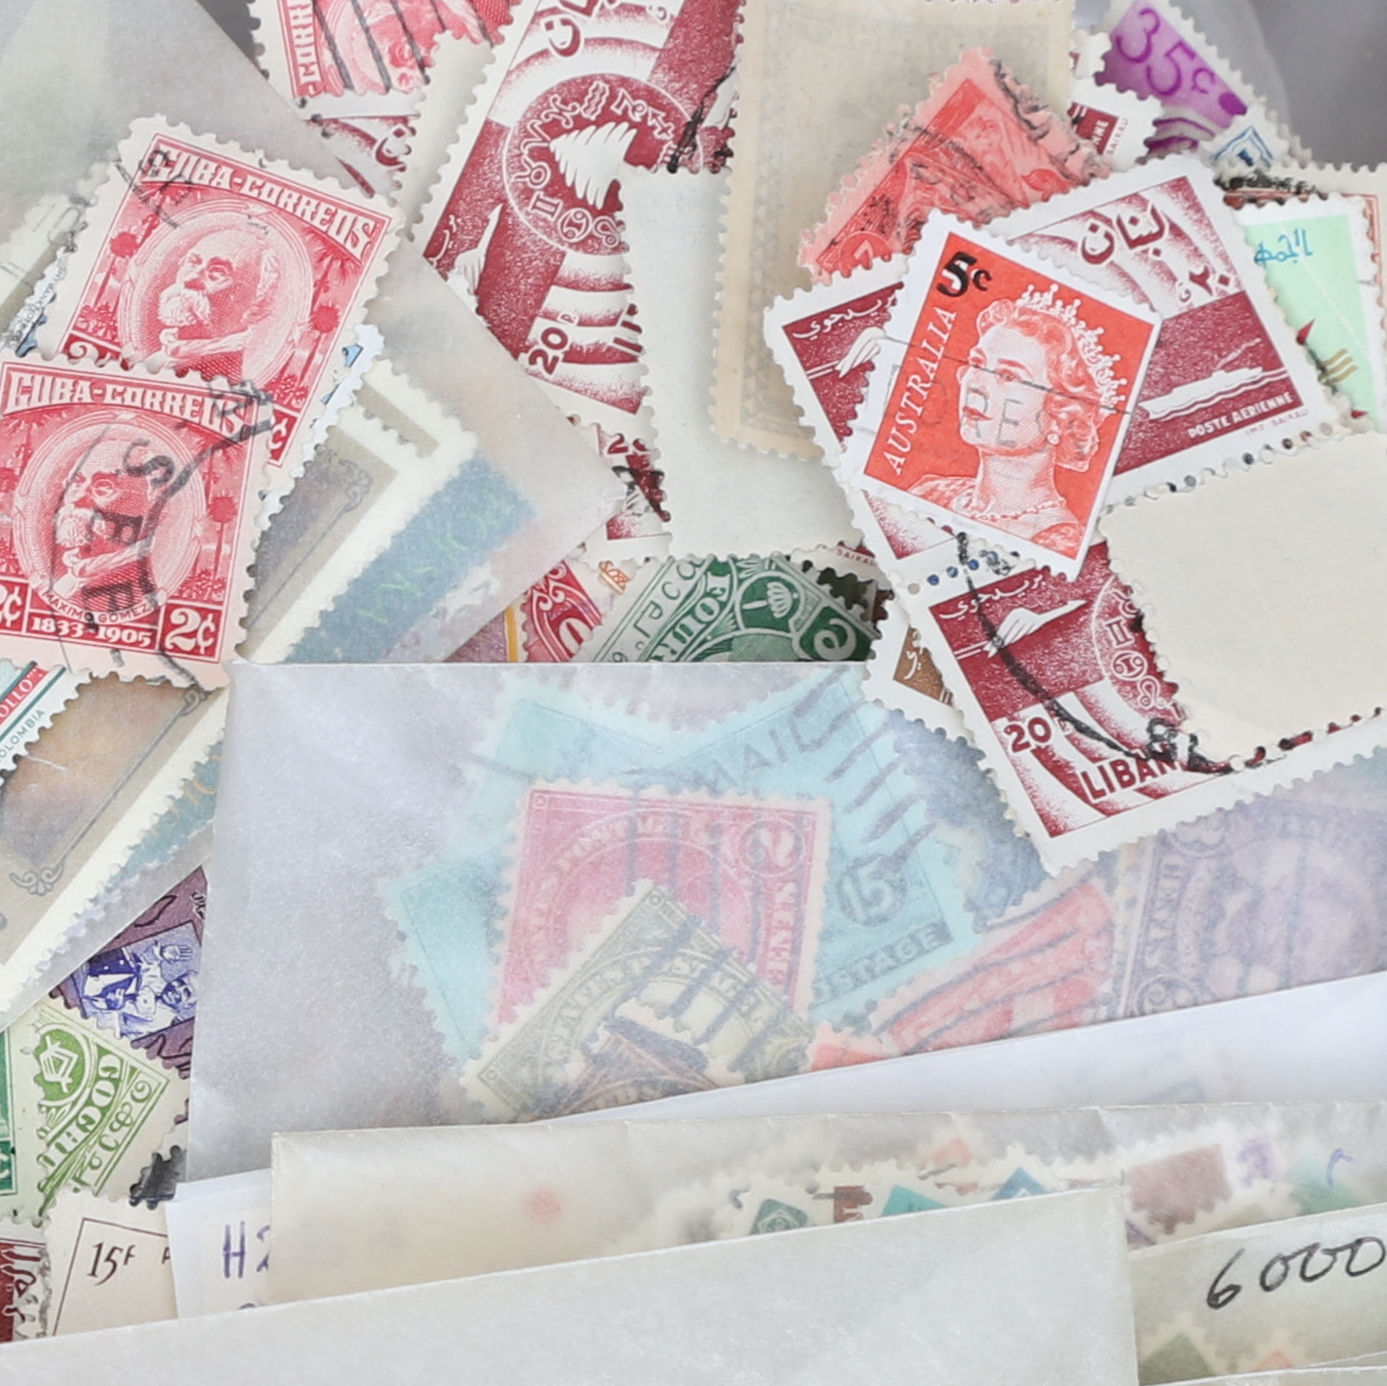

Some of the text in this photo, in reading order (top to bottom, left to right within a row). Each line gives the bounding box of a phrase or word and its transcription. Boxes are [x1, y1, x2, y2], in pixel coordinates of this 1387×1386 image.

[528, 324, 571, 374] 20
[880, 305, 958, 477] AUSTRALIA
[1187, 390, 1295, 439] POSTE AERIENNE
[1002, 714, 1053, 752] 20
